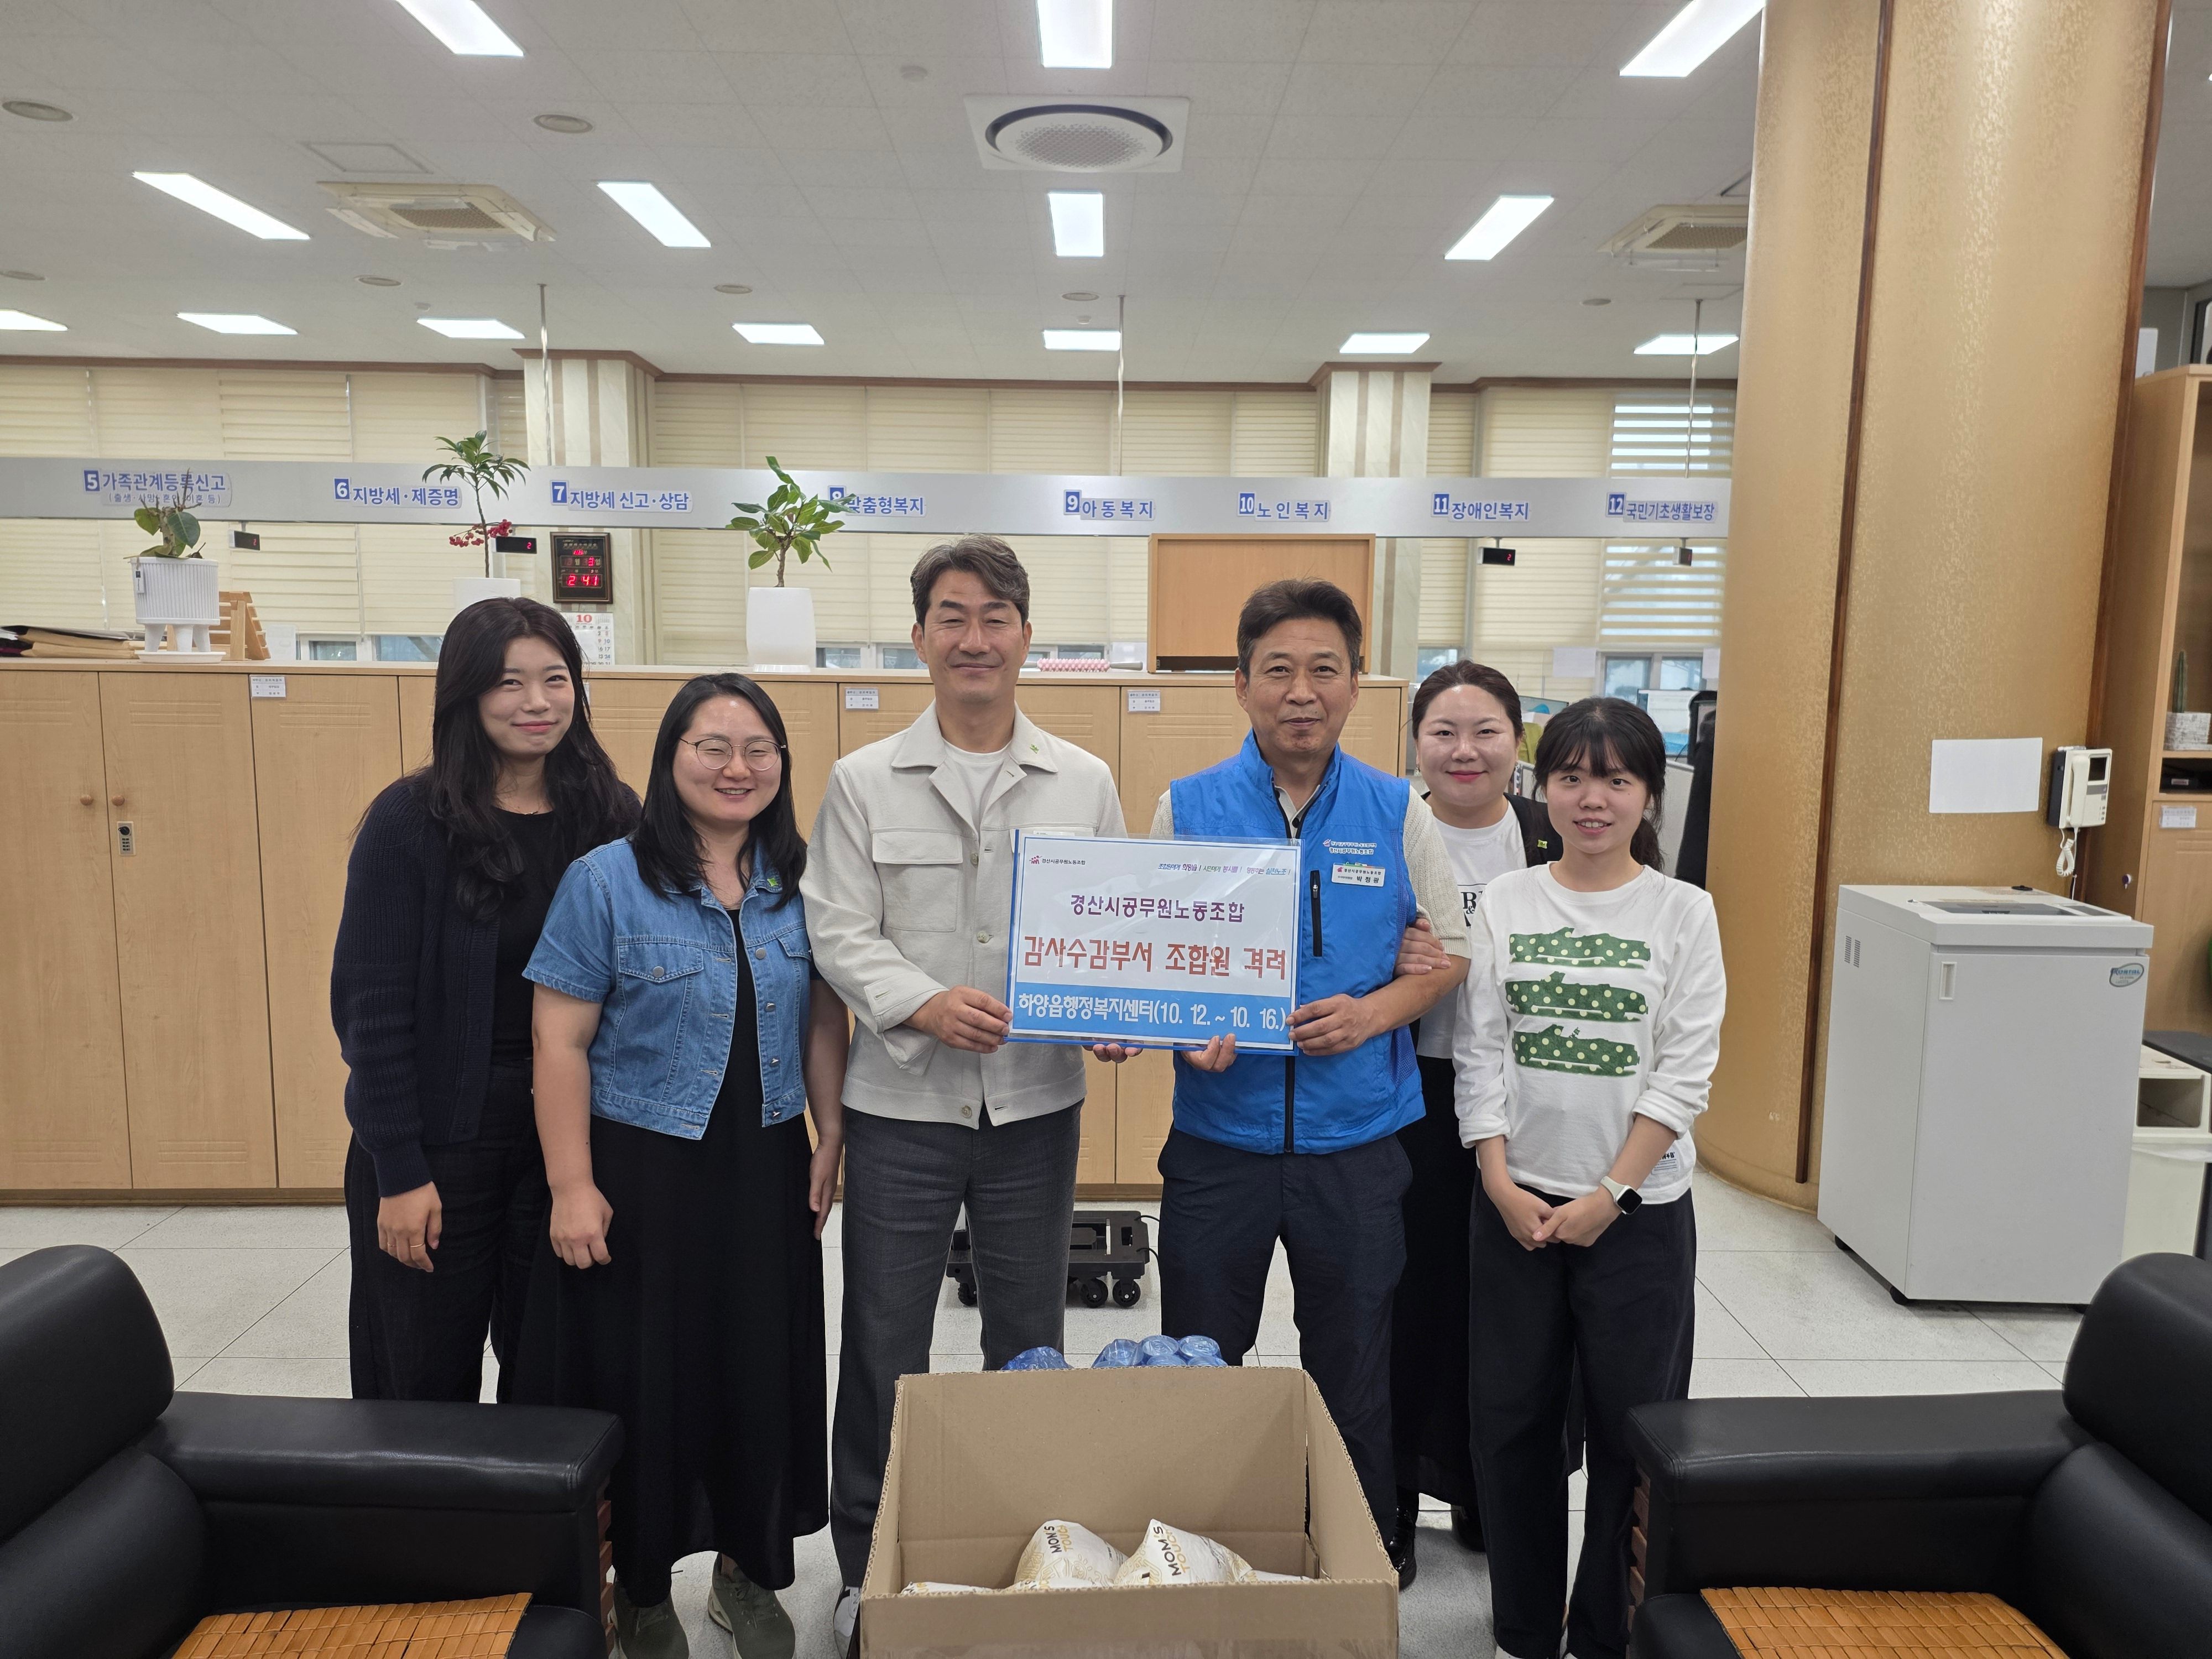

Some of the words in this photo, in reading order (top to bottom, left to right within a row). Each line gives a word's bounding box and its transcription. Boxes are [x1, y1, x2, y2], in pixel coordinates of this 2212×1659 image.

[86, 473, 98, 489] 5
[103, 472, 226, 492] 가족관계등록신고
[336, 482, 348, 498] 6
[353, 487, 459, 506] 지방세·제증명
[554, 486, 565, 501] 7
[570, 491, 615, 509] 지방세
[619, 492, 689, 510] 신고·상담
[847, 495, 924, 515] 맞춤형복지
[1067, 495, 1078, 510] 9
[1082, 500, 1152, 519] 아동복지
[1240, 497, 1254, 513] 10
[1256, 502, 1328, 519] 노인복지
[1434, 498, 1448, 513] 11
[1452, 502, 1528, 520] 장애인복지
[1609, 497, 1623, 513] 12
[1626, 502, 1714, 521] 국민기초생활보장
[576, 614, 592, 623] 10
[1071, 894, 1245, 923] 경산시공무원노동조합
[1024, 936, 1152, 972] 감사수감부서
[1165, 943, 1230, 977] 조합원
[1244, 947, 1286, 980] 격려
[1260, 1008, 1286, 1032] 16.)
[1153, 1526, 1182, 1576] MOM'S
